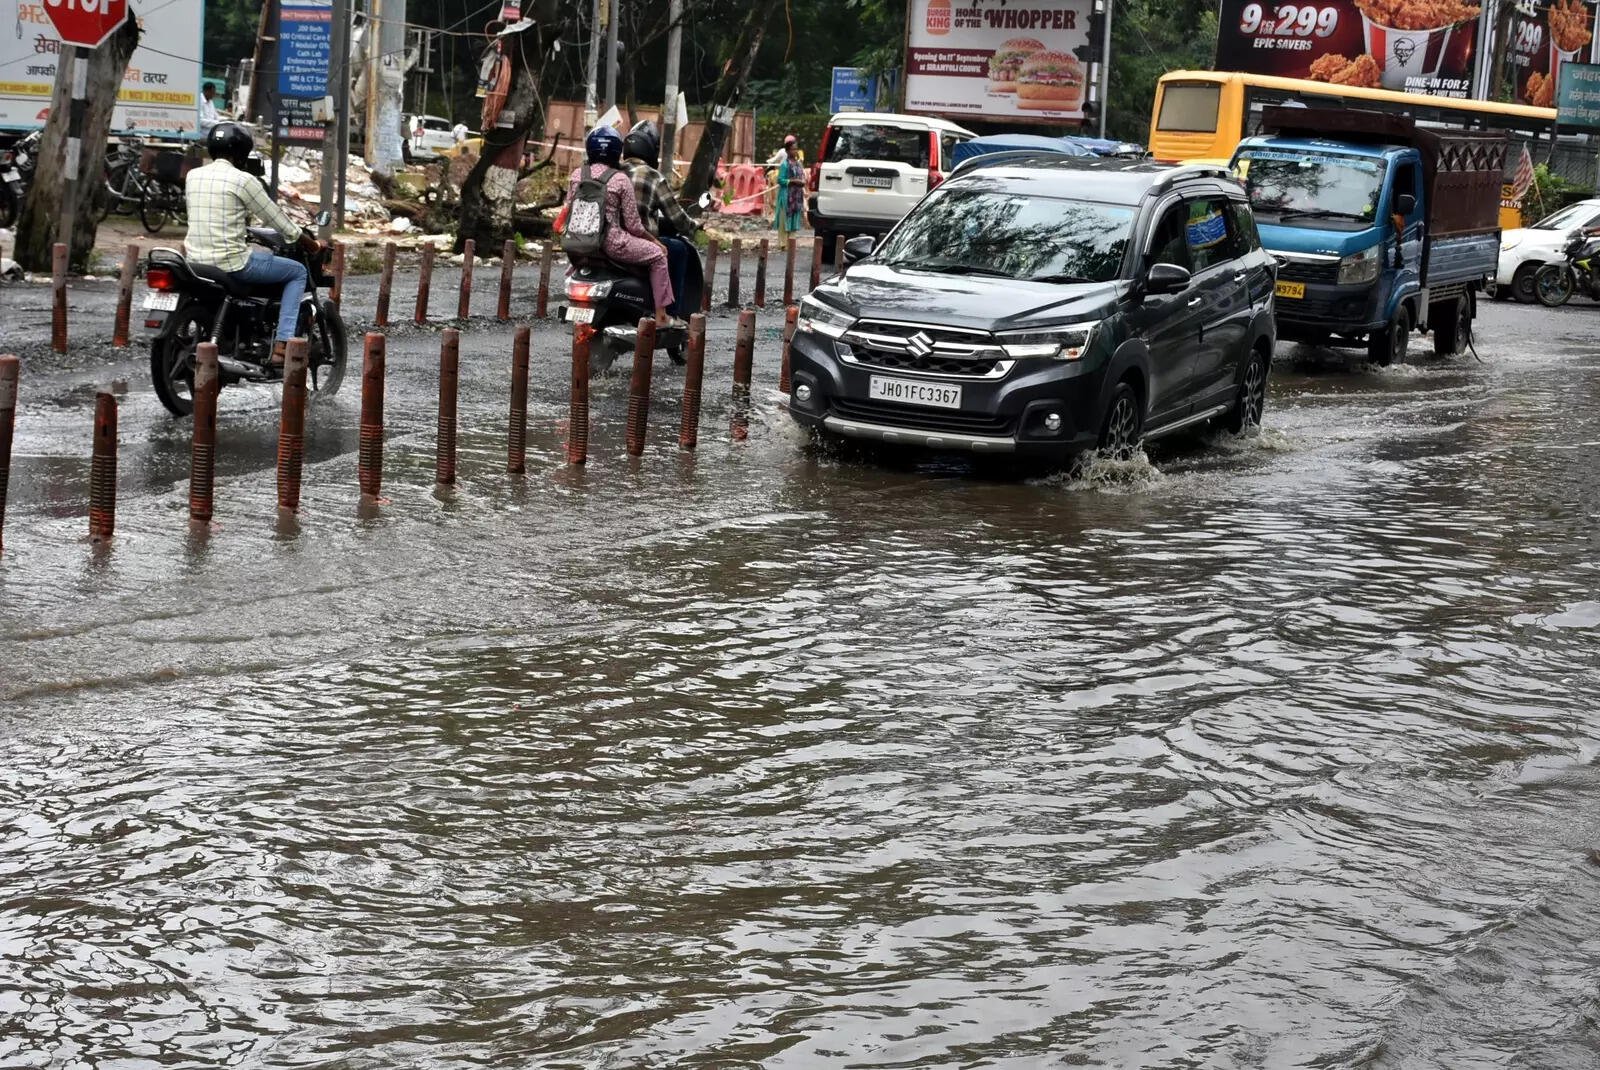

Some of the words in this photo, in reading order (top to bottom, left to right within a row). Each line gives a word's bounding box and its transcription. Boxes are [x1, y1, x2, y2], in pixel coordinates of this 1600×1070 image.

[927, 8, 952, 17] BURGER
[955, 8, 982, 17] HOME
[1240, 3, 1262, 33] 9
[927, 17, 950, 28] KING
[954, 19, 965, 28] OF
[965, 19, 982, 28] THE
[984, 9, 1077, 30] WHOPPER
[1253, 38, 1276, 49] EPIC
[1276, 39, 1313, 50] SAVERS
[914, 53, 938, 63] Opening
[938, 53, 949, 62] On
[957, 54, 988, 64] September
[143, 72, 168, 84] तत्पर
[1405, 76, 1441, 88] DINE-IN
[1442, 79, 1461, 90] FOR
[1461, 80, 1469, 90] 2
[879, 382, 959, 404] JH01FC3367
